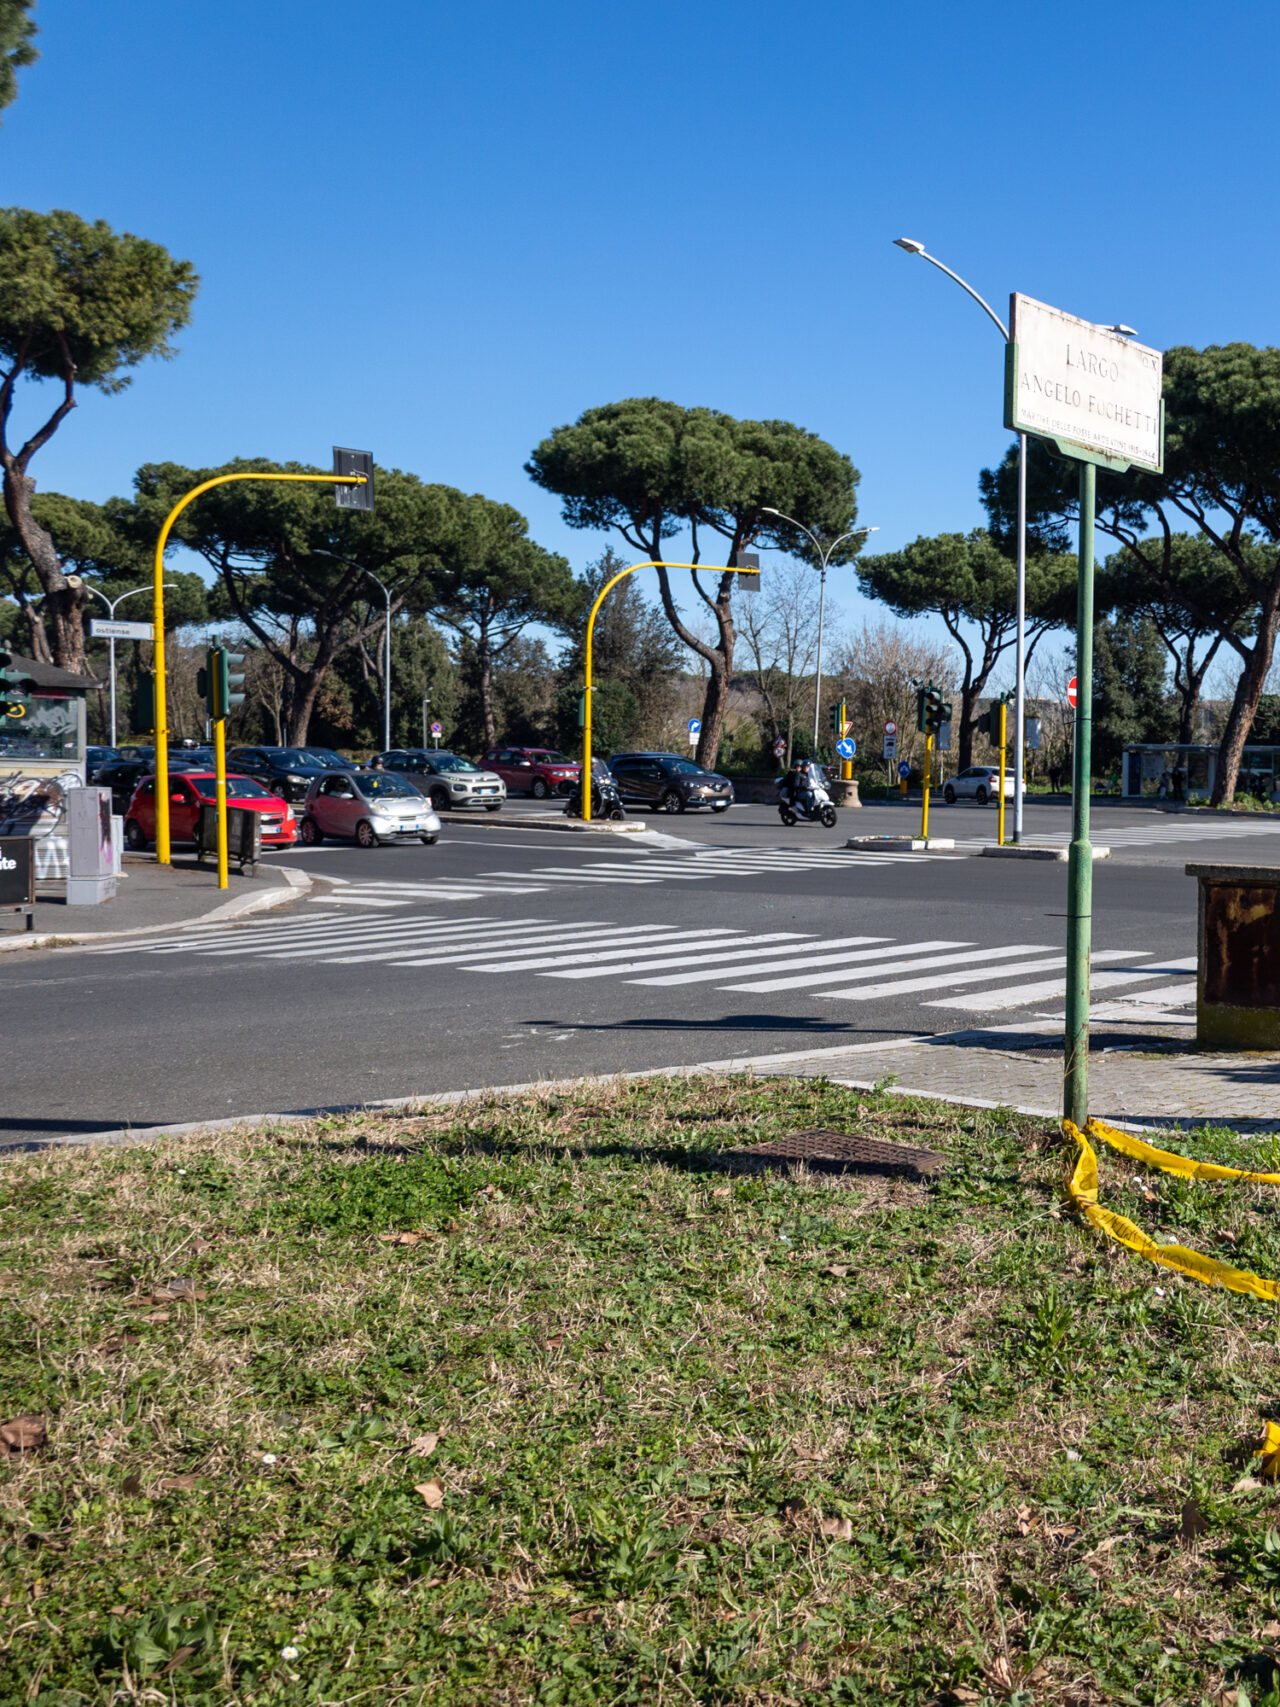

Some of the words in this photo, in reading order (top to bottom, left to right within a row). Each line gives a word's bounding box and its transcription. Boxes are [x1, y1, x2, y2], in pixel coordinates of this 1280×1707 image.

[1066, 343, 1119, 382] LARGO
[1020, 372, 1081, 408] ANGELO
[1088, 395, 1157, 435] FOCHETTI
